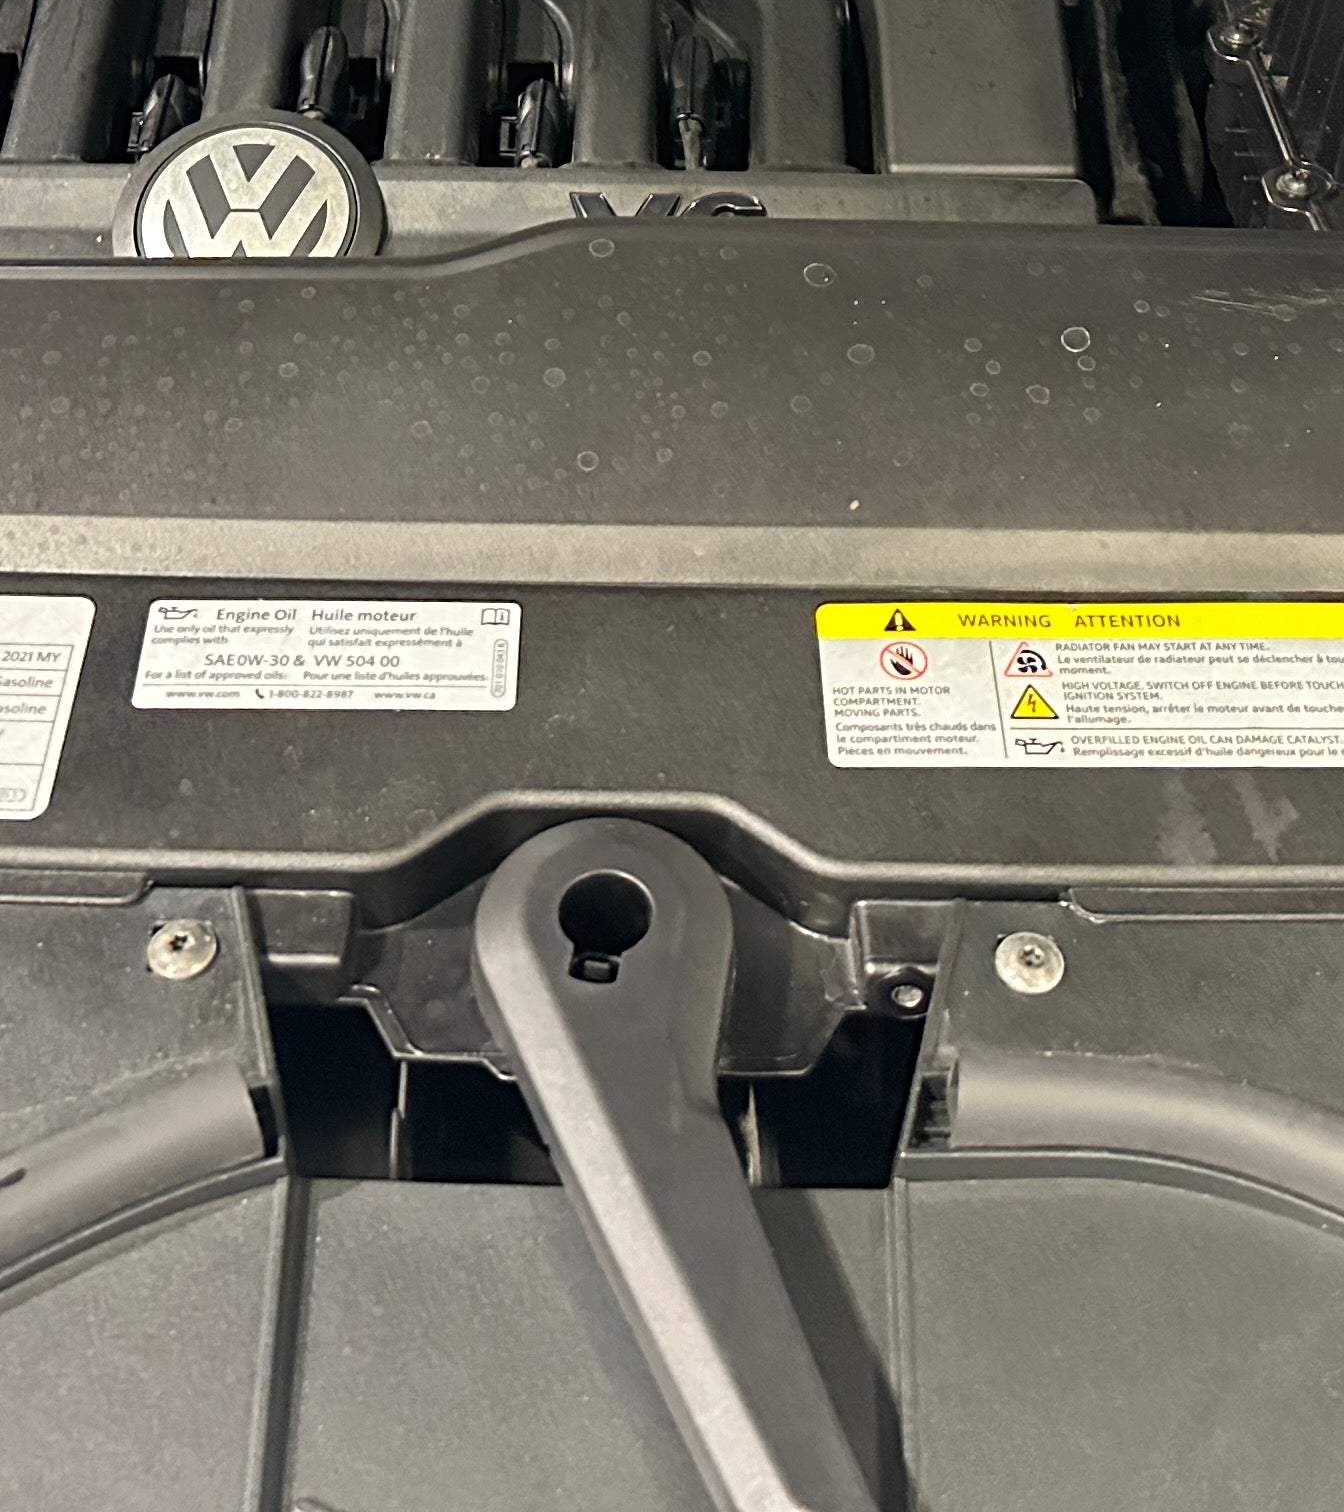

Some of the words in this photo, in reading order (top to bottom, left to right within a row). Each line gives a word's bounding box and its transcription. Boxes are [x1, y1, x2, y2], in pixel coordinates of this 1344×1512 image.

[217, 609, 270, 623] Engine
[275, 609, 296, 620] Oil
[312, 609, 353, 621] Huile
[358, 611, 416, 621] moteur
[958, 614, 1051, 628] WARNING
[1075, 614, 1180, 627] ATTENTION
[154, 625, 174, 633] Use
[177, 626, 200, 636] only
[202, 625, 217, 633] oil
[218, 625, 240, 633] that
[244, 625, 294, 635] expressly
[309, 626, 350, 635] Utilisez
[353, 627, 421, 637] uniquement
[424, 627, 438, 635] de
[308, 638, 325, 647] qui
[1056, 643, 1110, 651] RADIATOR
[1114, 643, 1135, 651] FAN
[1138, 643, 1160, 651] MAY
[1164, 642, 1196, 651] START
[1200, 642, 1212, 650] AT
[1215, 642, 1236, 650] ANY
[2, 651, 33, 661] 2021
[36, 652, 61, 662] MY
[293, 655, 305, 666] &
[314, 655, 342, 666] VW
[346, 655, 375, 667] 504
[380, 656, 400, 667] 00
[1058, 655, 1070, 664] Le
[1073, 655, 1134, 664] ventilateur
[1138, 655, 1151, 663] de
[1154, 655, 1205, 663] radiateur
[1209, 656, 1234, 665] peut
[1253, 654, 1313, 664] déclencher
[145, 671, 162, 679] For
[175, 670, 191, 678] list
[194, 670, 206, 679] of
[209, 671, 262, 681] approved
[304, 672, 328, 680] Pour
[354, 672, 376, 680] liste
[1216, 681, 1256, 689] ENGINE
[1261, 681, 1303, 689] BEFORE
[833, 687, 855, 695] HOT
[858, 687, 892, 695] PARTS
[1064, 692, 1114, 700] IGNITION
[835, 709, 880, 717] MOVING
[1066, 705, 1100, 713] Haute
[1153, 704, 1190, 713] arrêter
[1194, 704, 1204, 712] le
[1207, 705, 1248, 713] moteur
[1252, 705, 1284, 713] avant
[1287, 704, 1301, 713] de
[836, 722, 903, 732] Composants
[906, 722, 927, 731] très
[929, 722, 968, 731] chauds
[970, 722, 996, 731] dans
[850, 735, 932, 744] compartiment
[1070, 736, 1140, 744] OVERFILLED
[1143, 736, 1185, 744] ENGINE
[1188, 736, 1207, 744] OIL
[1210, 736, 1232, 744] CAN
[1236, 736, 1283, 744] DAMAGE
[838, 747, 874, 755] Pièces
[1073, 747, 1145, 758] Remplissage
[1148, 747, 1191, 756] excessif
[1299, 748, 1324, 757] pour
